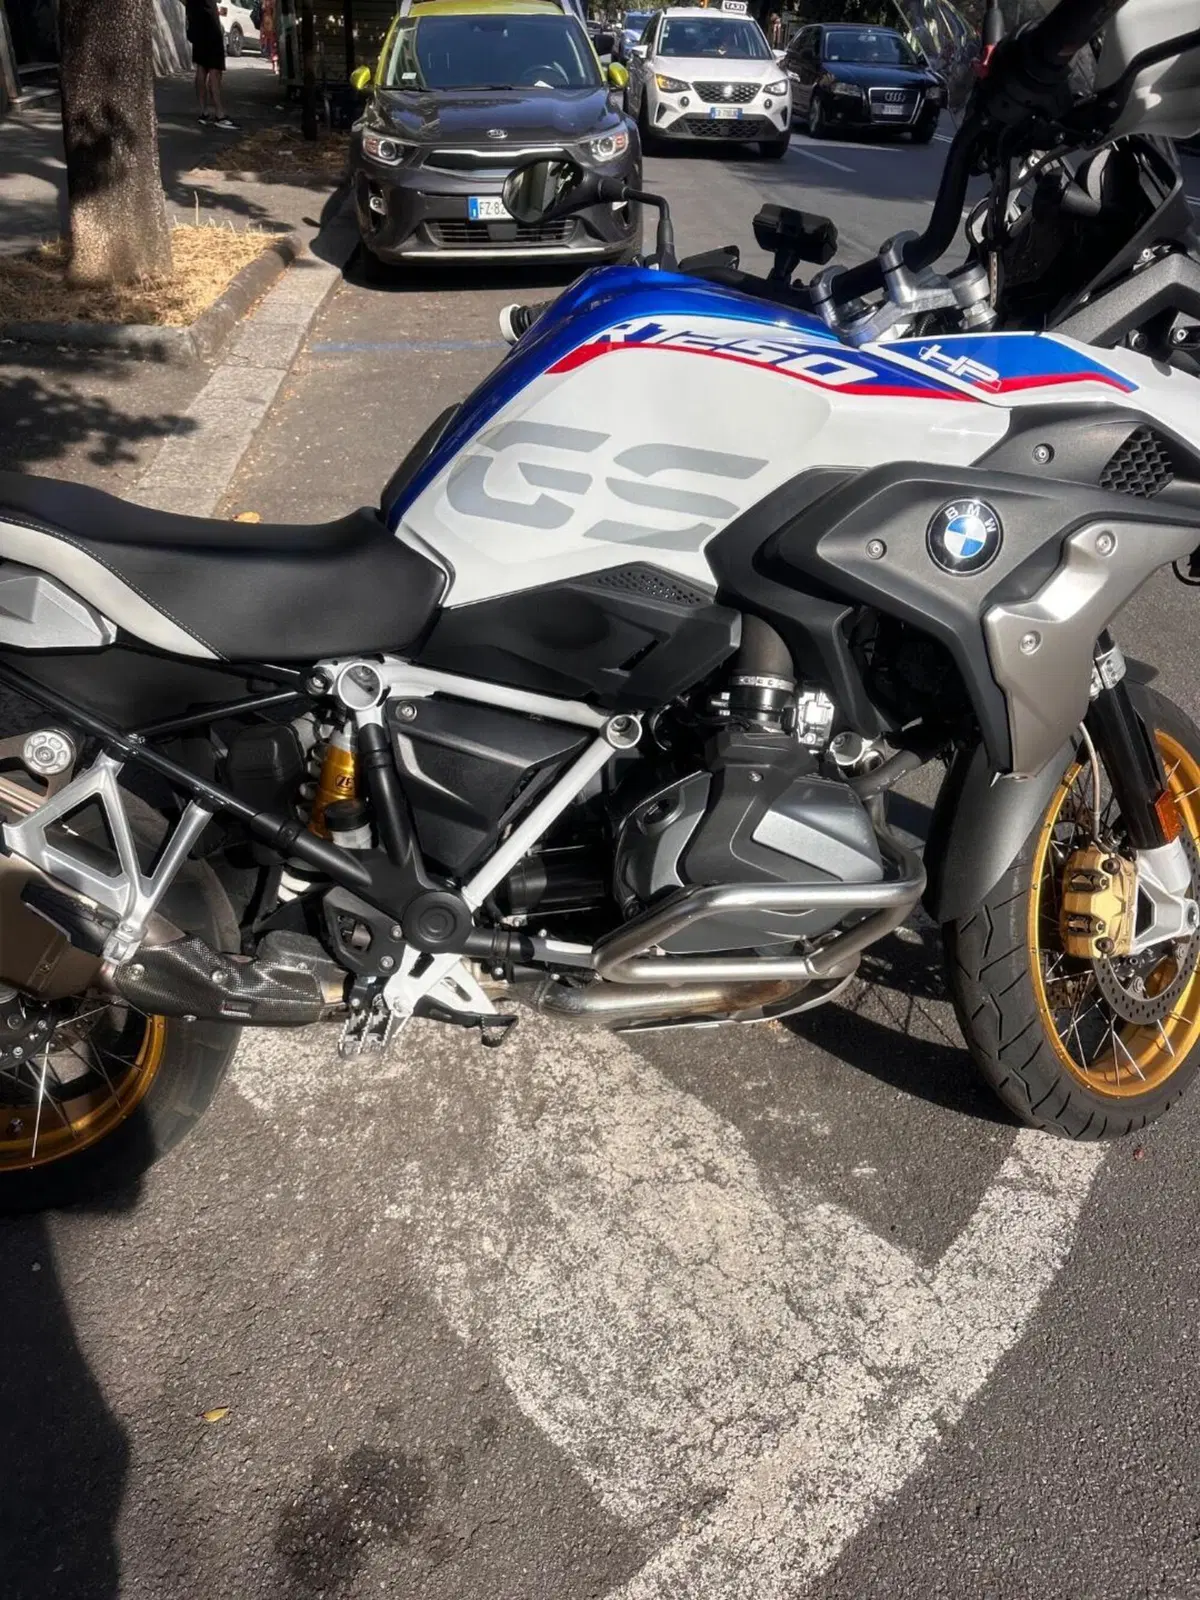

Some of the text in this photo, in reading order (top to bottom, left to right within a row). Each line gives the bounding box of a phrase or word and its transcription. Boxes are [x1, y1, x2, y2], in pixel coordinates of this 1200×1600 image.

[919, 344, 1001, 391] HP
[446, 420, 769, 553] GS
[944, 503, 997, 533] BMW
